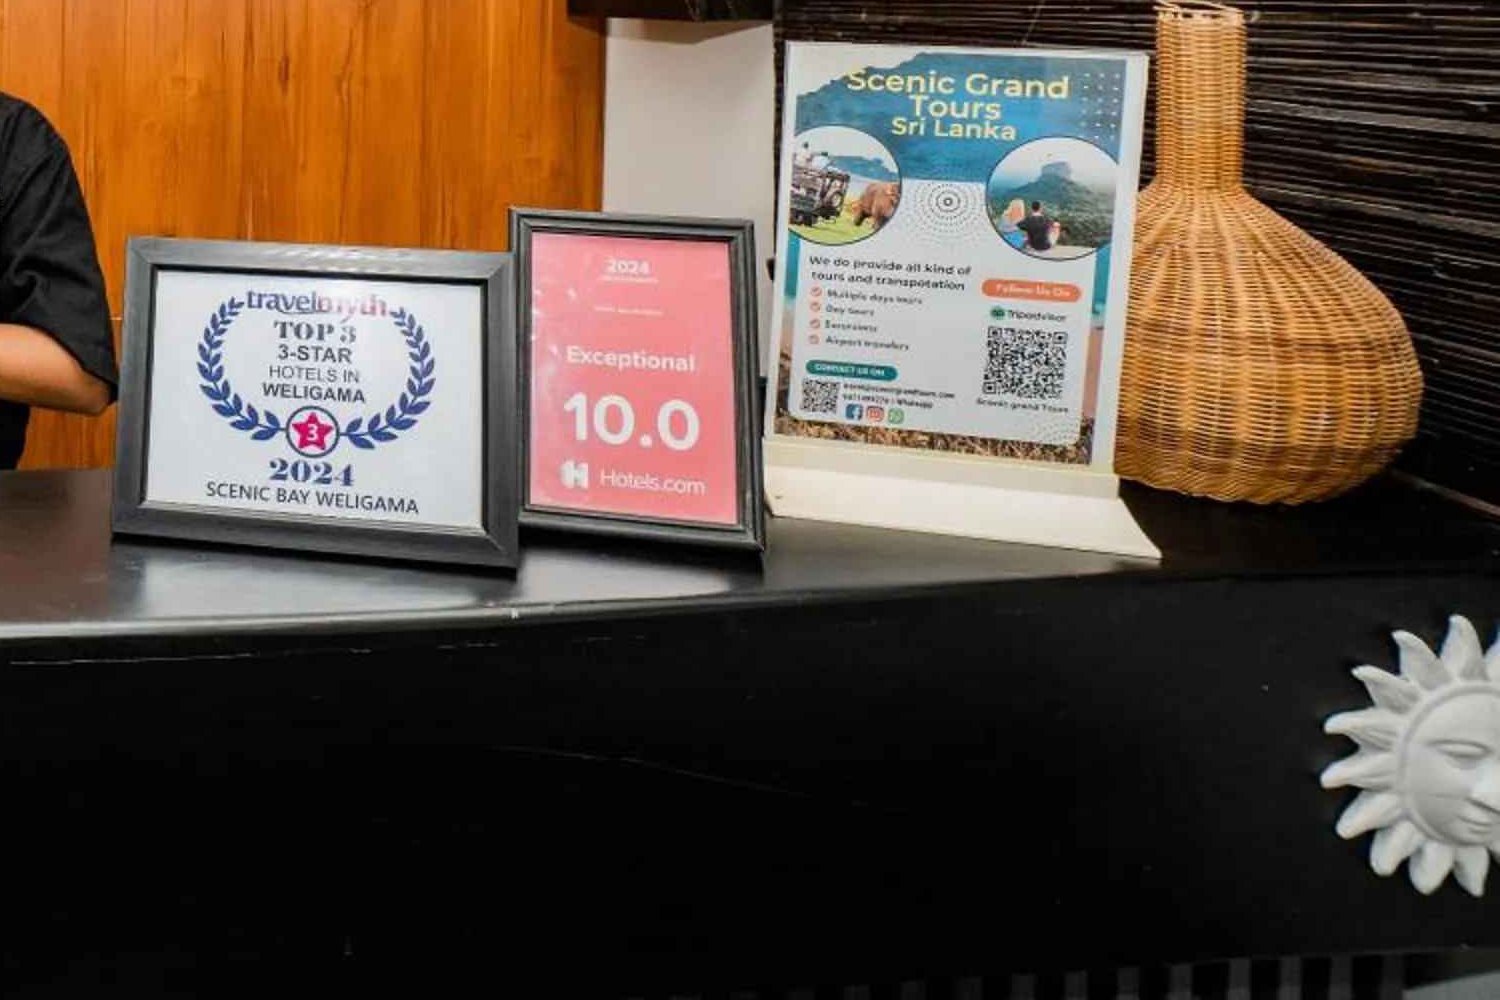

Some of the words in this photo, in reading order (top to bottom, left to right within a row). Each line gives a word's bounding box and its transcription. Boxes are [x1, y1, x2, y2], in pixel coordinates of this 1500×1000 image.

[847, 71, 956, 95] Scenic
[964, 73, 1070, 100] Grand
[909, 94, 1002, 121] Tours
[891, 116, 925, 137] Sri
[934, 118, 1017, 141] Lanka
[605, 258, 651, 275] 2024
[809, 255, 831, 266] We
[833, 256, 851, 267] do
[853, 258, 902, 273] provide
[905, 262, 921, 273] all
[924, 264, 954, 275] kind
[957, 265, 971, 276] of
[811, 270, 845, 282] tours
[847, 273, 873, 284] and
[876, 277, 966, 292] transpotation
[273, 320, 335, 342] TOP
[339, 325, 357, 344] 3
[277, 345, 352, 363] 3-STAR
[566, 345, 695, 373] Exceptional
[269, 365, 339, 383] HOTELS
[343, 368, 360, 384] IN
[262, 384, 366, 404] WELIGAMA
[305, 422, 318, 442] 3
[563, 391, 700, 450] 10.0
[268, 459, 355, 487] 2024
[600, 468, 706, 496] Hotels.com
[206, 482, 272, 503] SCENIC
[276, 485, 312, 505] BAY
[316, 491, 419, 514] WELIGAMA
